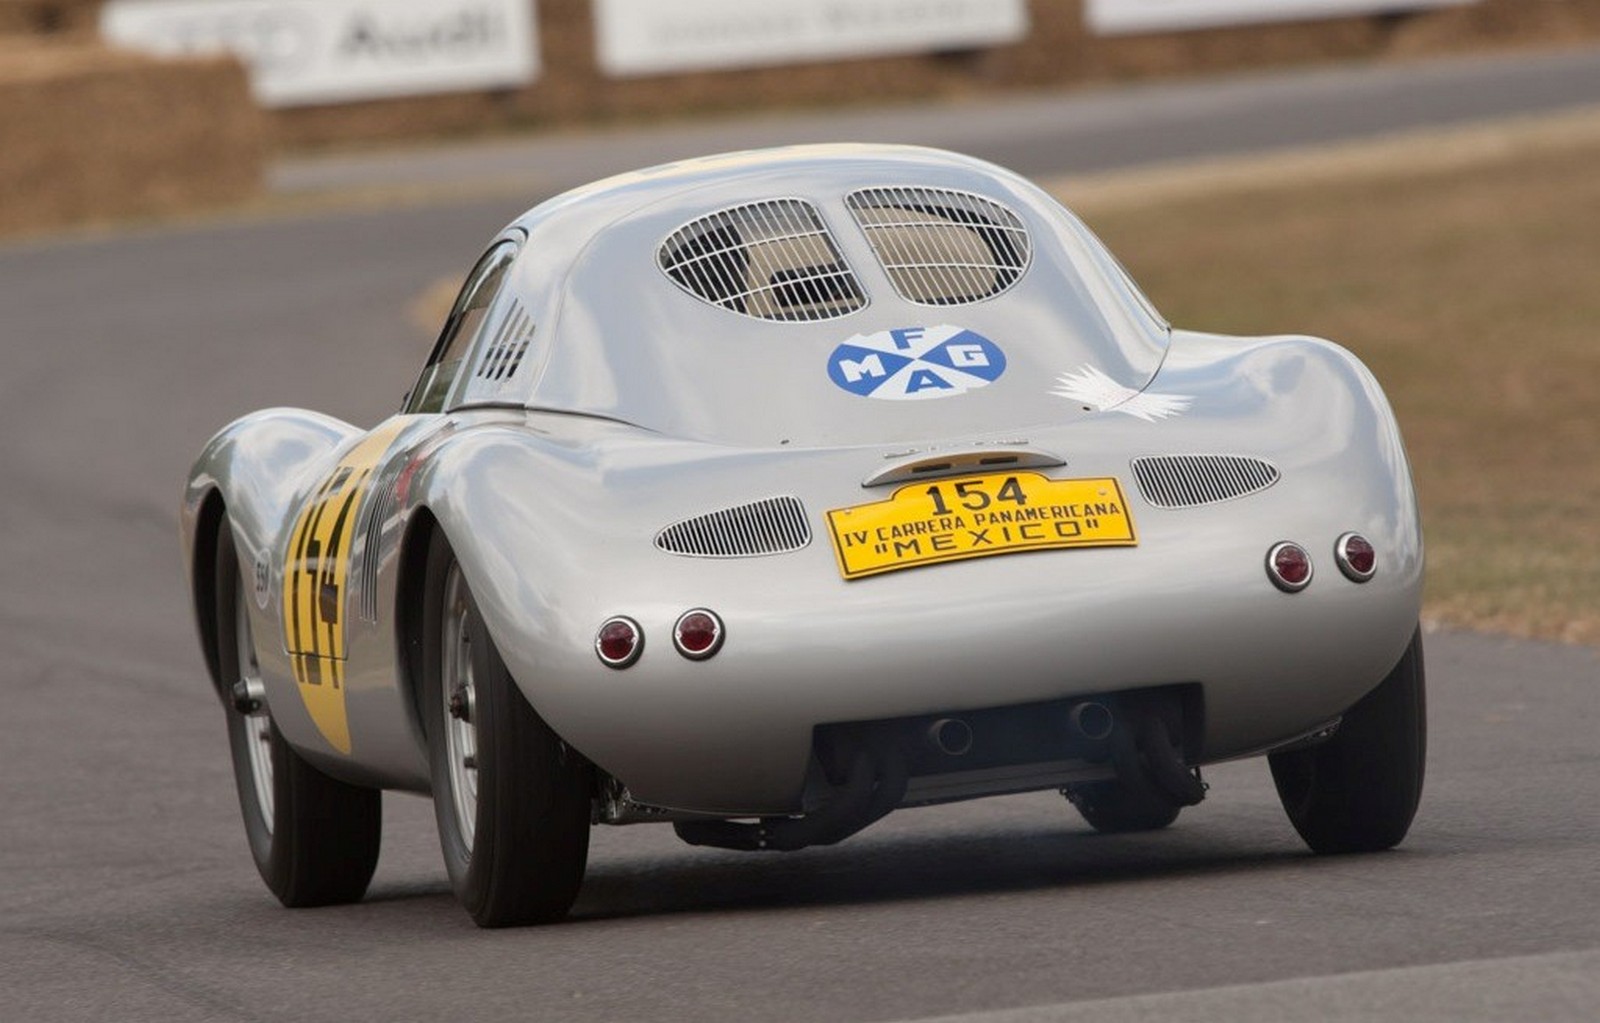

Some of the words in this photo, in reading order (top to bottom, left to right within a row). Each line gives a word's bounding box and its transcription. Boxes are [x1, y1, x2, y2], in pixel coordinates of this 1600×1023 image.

[889, 327, 925, 350] F
[839, 354, 886, 383] M
[946, 344, 990, 367] G
[905, 369, 954, 394] A
[926, 477, 1027, 516] 154
[844, 530, 869, 547] IV
[877, 516, 965, 541] CARRERA
[975, 502, 1121, 526] PANAMERICANA
